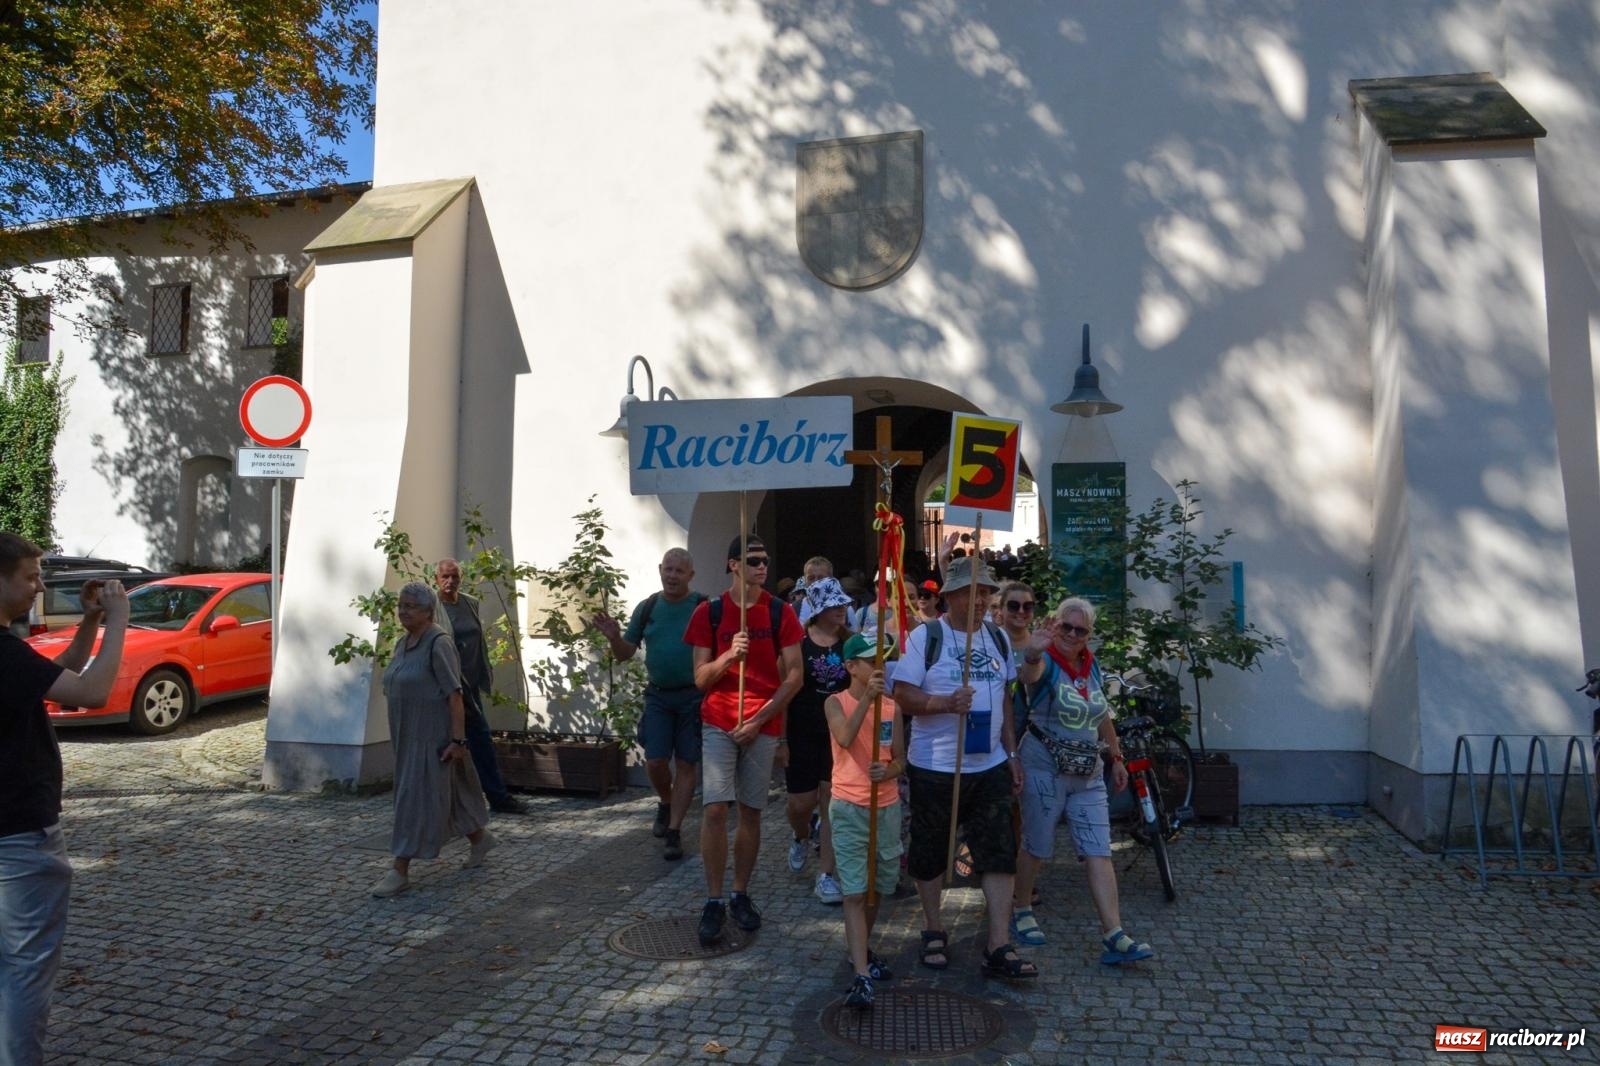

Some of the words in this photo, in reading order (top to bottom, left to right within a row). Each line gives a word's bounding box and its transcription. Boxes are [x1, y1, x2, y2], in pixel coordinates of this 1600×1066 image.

[268, 452, 293, 460] dotyczy
[636, 419, 848, 471] Racibórz
[251, 460, 295, 468] pracowników
[957, 425, 1008, 501] 5
[1056, 487, 1121, 497] MASZYNOWNIA
[1058, 683, 1108, 731] 52
